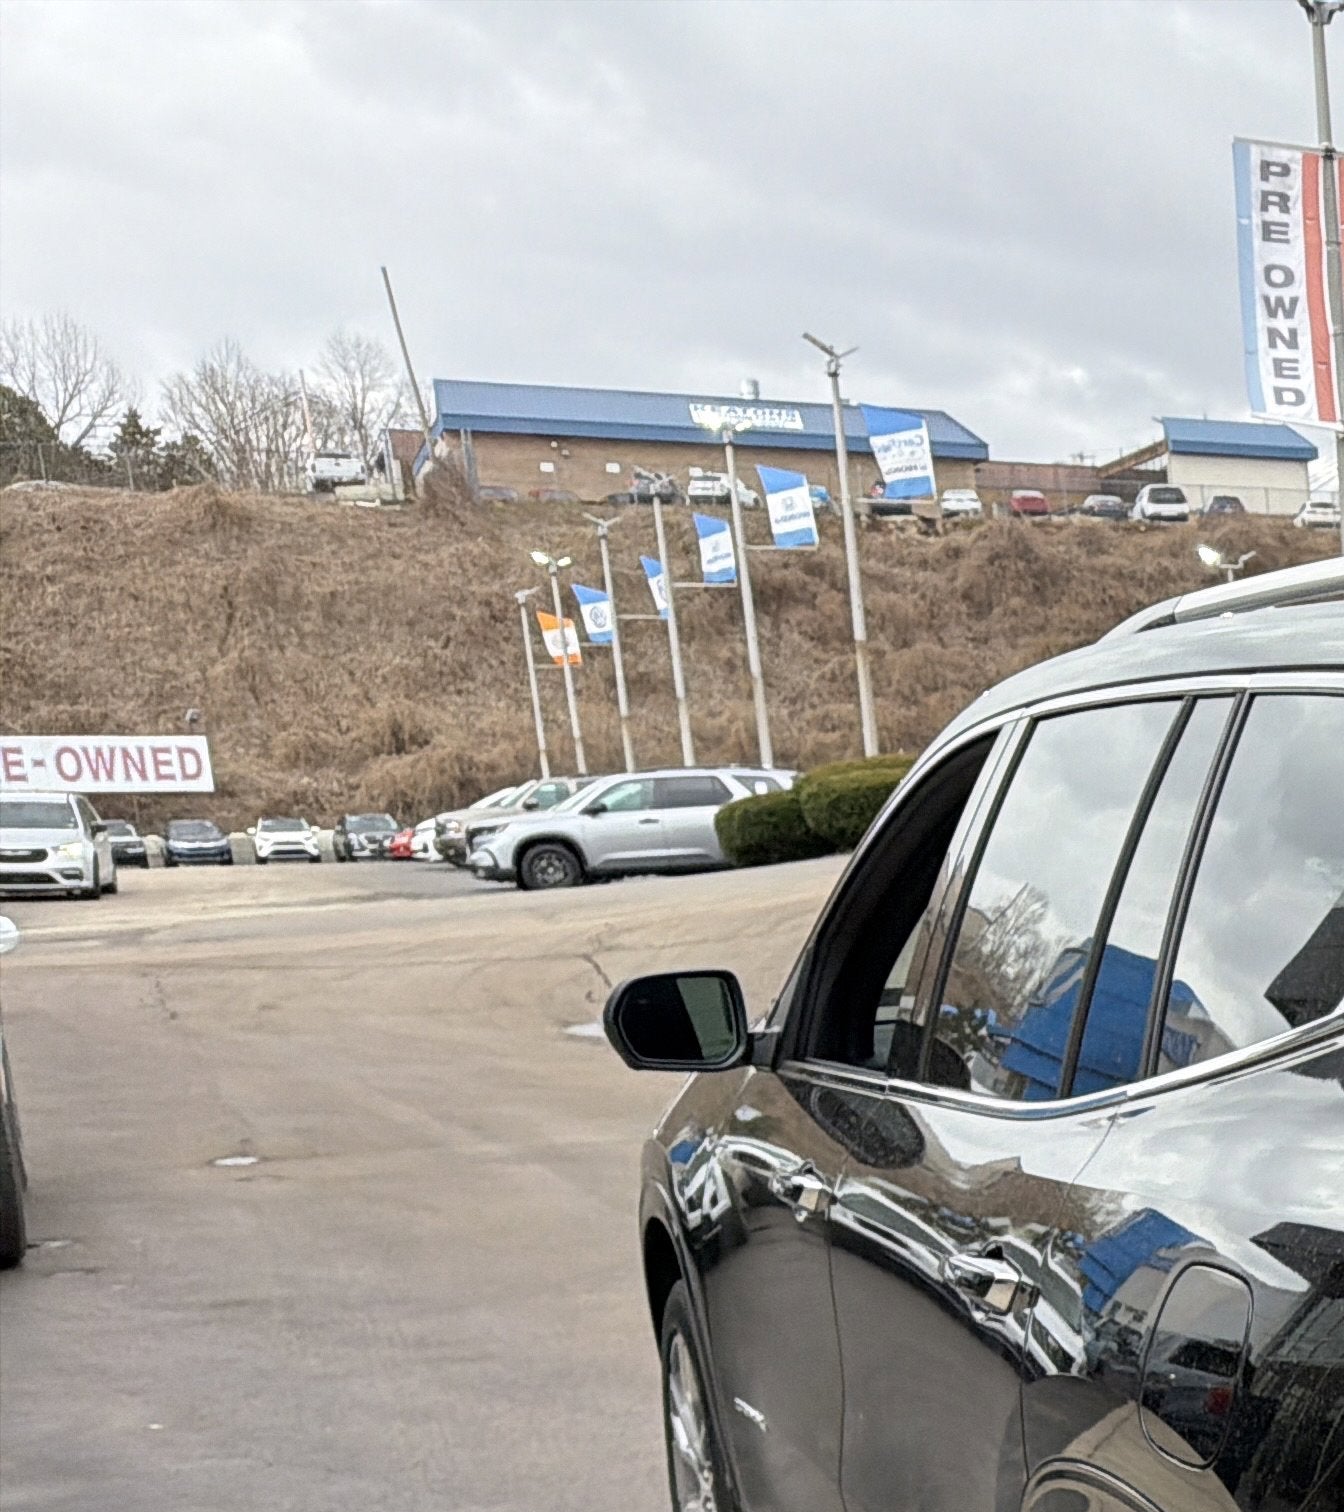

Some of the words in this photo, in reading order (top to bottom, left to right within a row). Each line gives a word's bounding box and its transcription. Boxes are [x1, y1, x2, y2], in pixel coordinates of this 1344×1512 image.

[1259, 160, 1291, 244] PRE
[1263, 264, 1305, 407] OWNED
[0, 746, 203, 783] E-OWNED
